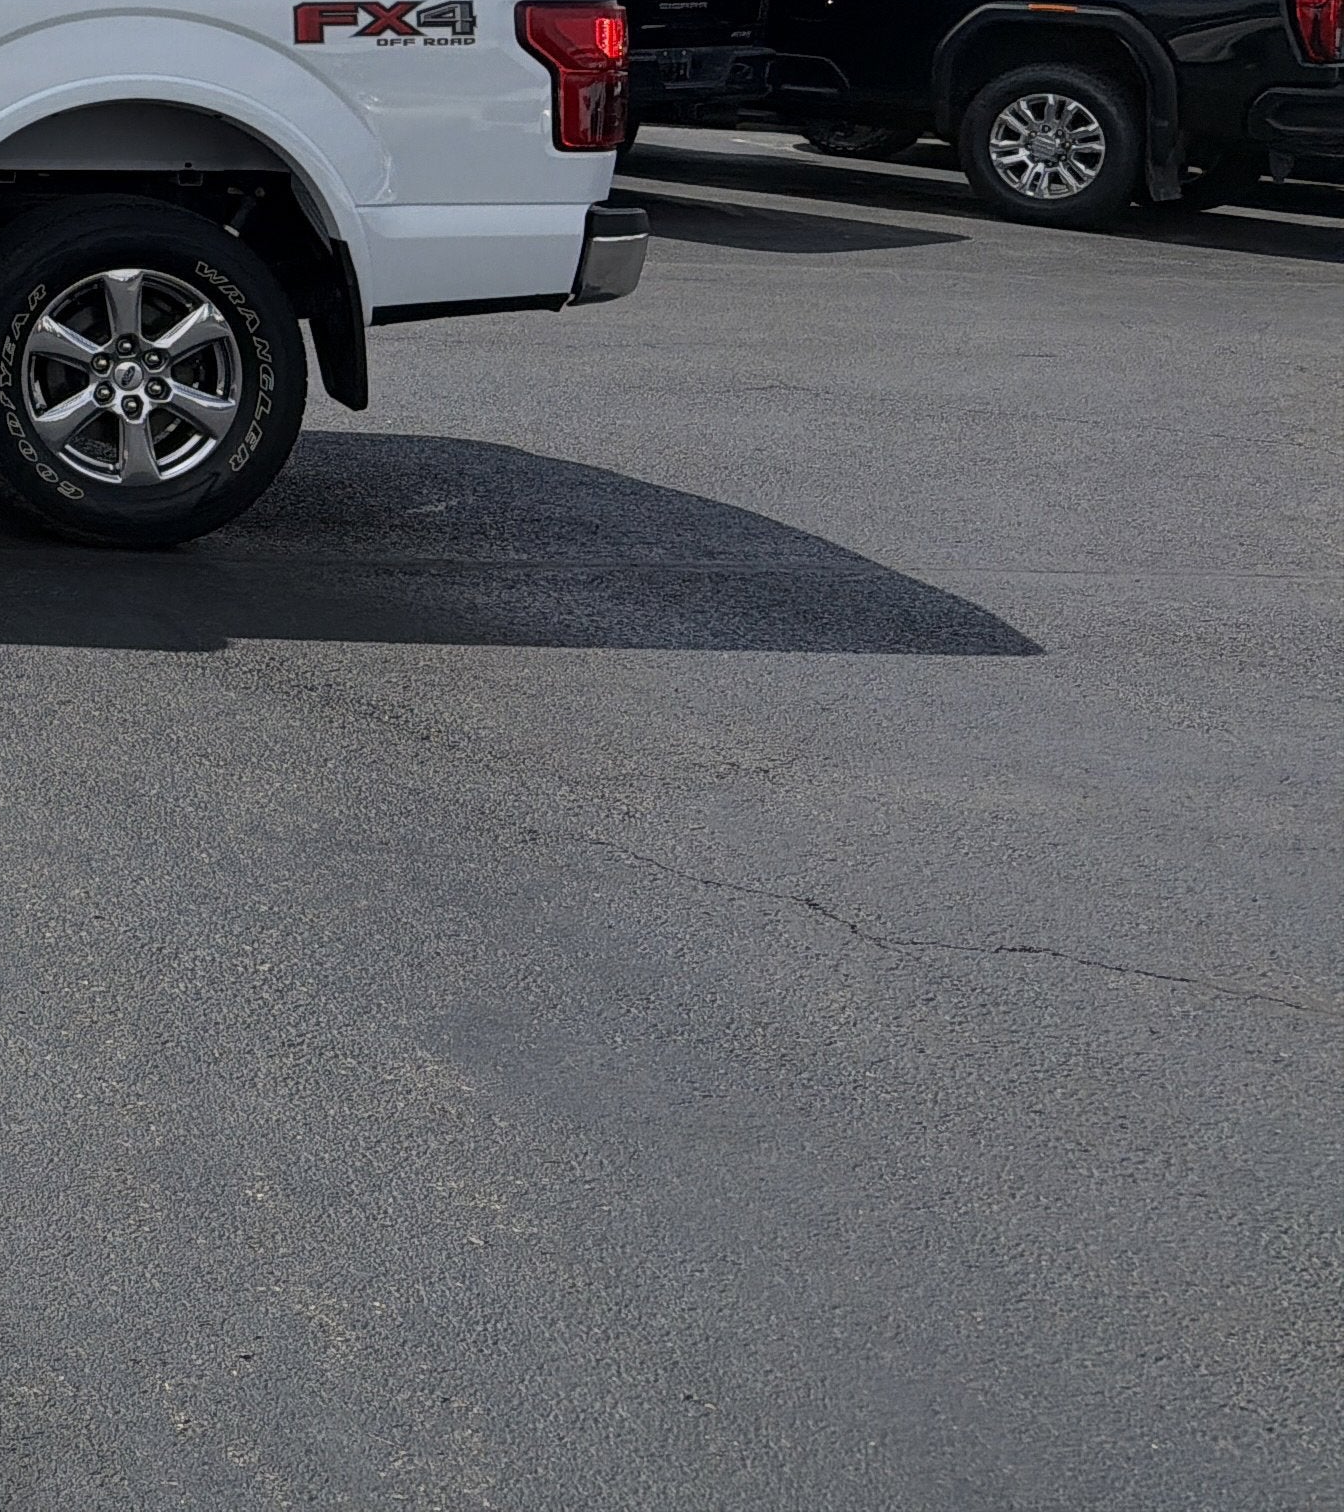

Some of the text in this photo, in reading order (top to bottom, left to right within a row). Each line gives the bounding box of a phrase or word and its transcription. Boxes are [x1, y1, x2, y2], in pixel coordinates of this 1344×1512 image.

[293, 0, 477, 44] FX4
[376, 38, 476, 47] OFF ROAD
[195, 260, 275, 473] WRANGLER
